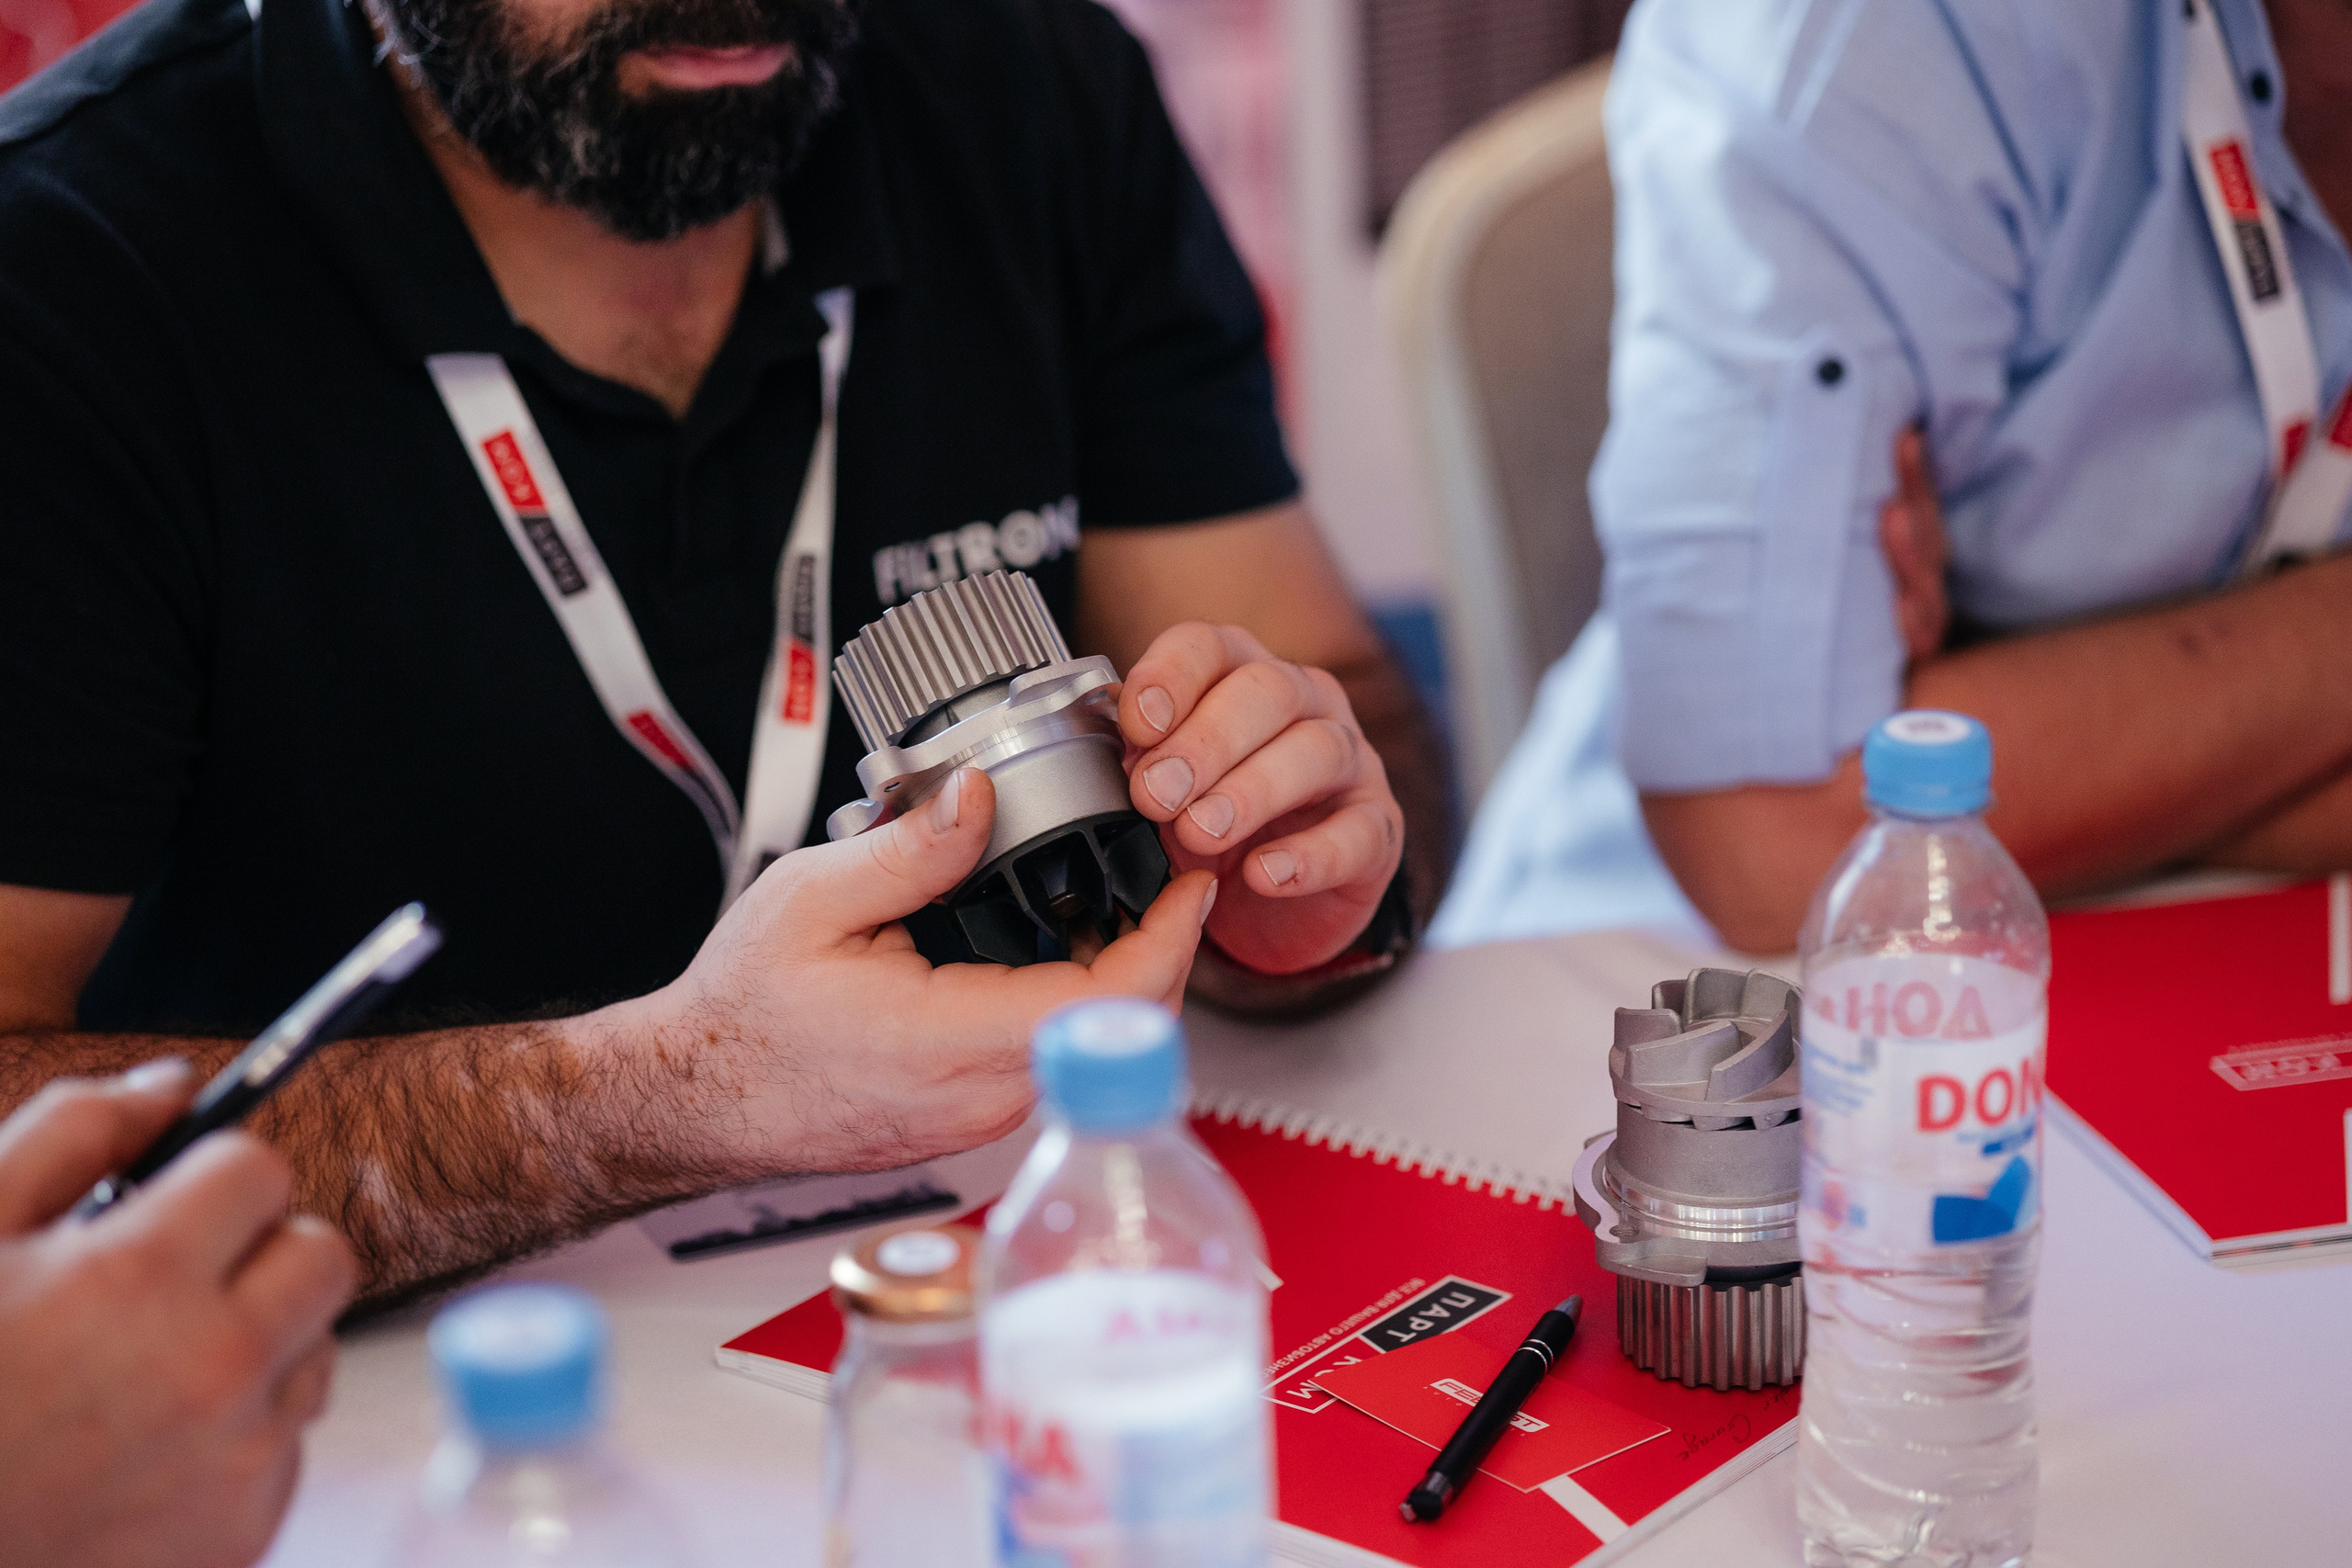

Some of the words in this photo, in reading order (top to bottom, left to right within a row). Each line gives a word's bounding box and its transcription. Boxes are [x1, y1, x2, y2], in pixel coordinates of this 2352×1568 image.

[1385, 1291, 1476, 1343] ПАРТ
[1261, 1333, 1332, 1378] АВТОБИЗНЕС
[1439, 1382, 1542, 1427] FEST
